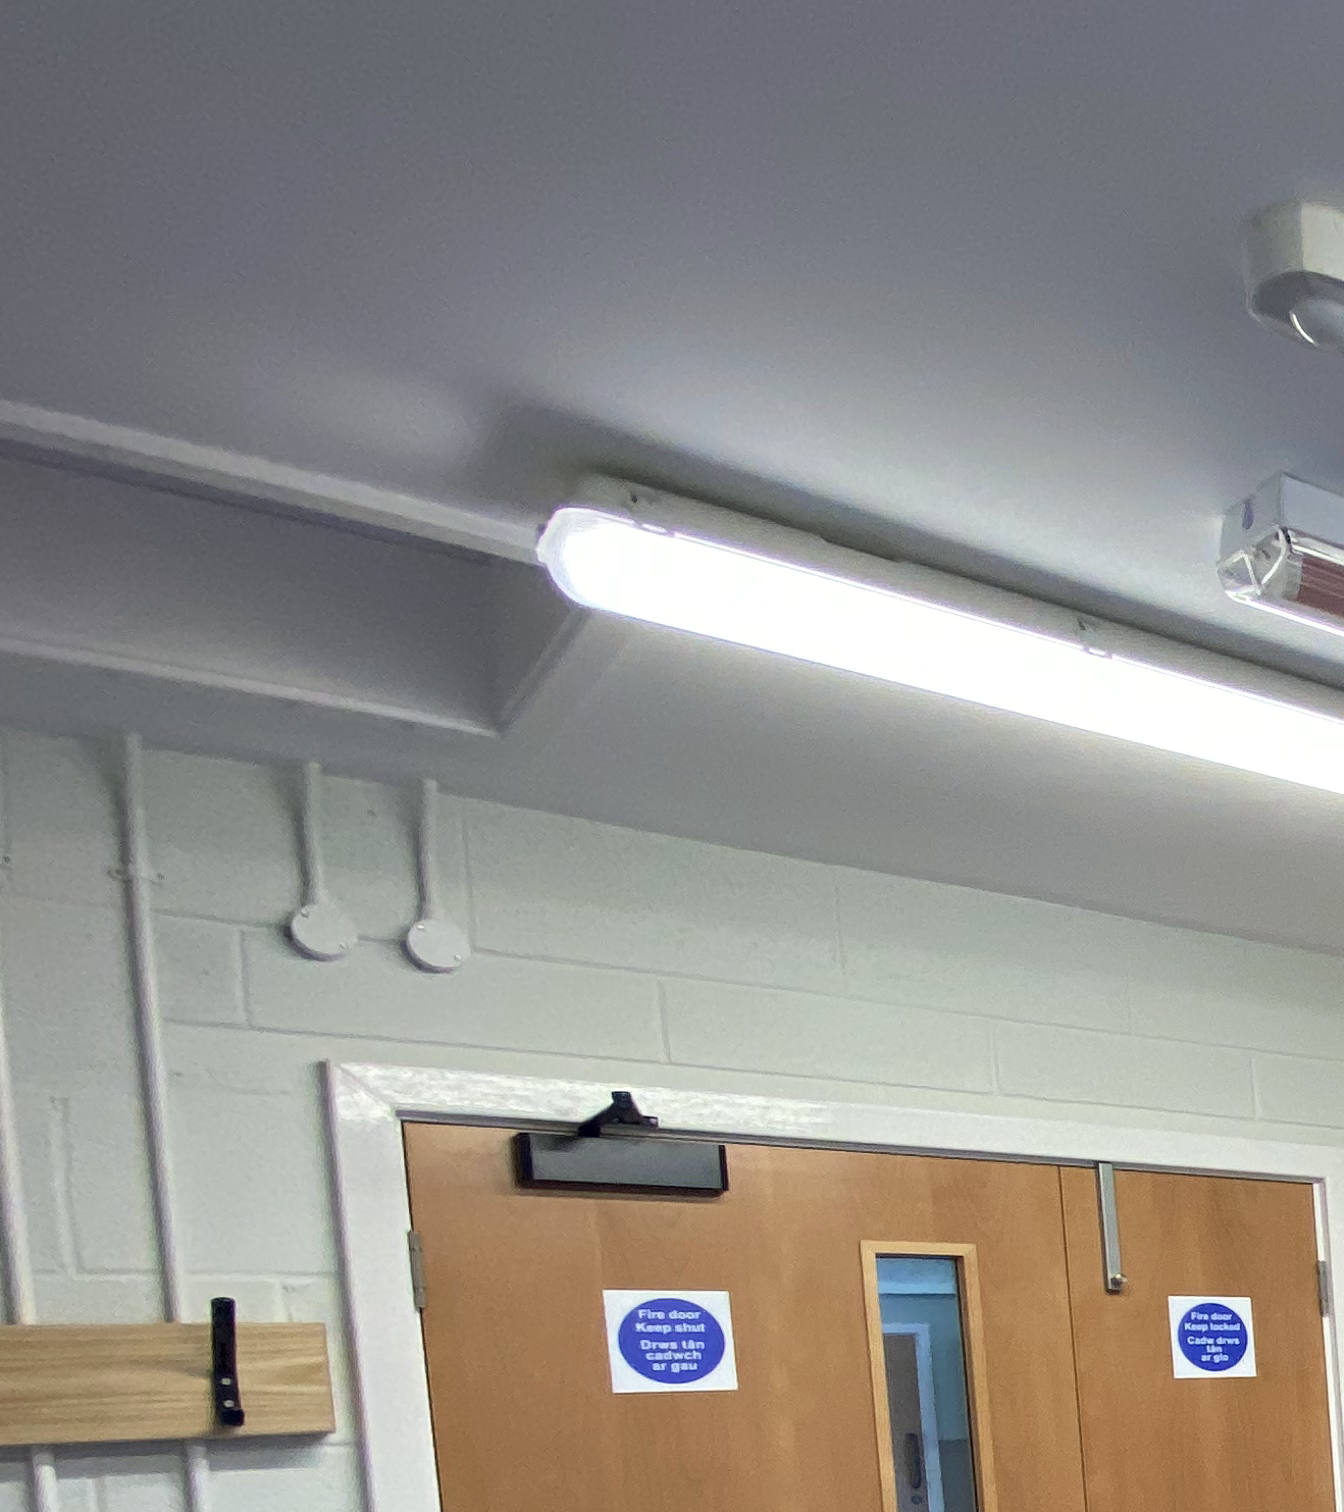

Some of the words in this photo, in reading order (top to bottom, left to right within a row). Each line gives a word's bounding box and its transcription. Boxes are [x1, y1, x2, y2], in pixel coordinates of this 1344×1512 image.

[638, 1309, 665, 1320] Fire
[669, 1309, 701, 1320] door
[1191, 1312, 1209, 1320] Fire
[1211, 1312, 1232, 1320] door
[636, 1322, 671, 1335] Keep
[675, 1322, 705, 1333] shut
[1184, 1323, 1208, 1332] Keep
[1210, 1323, 1241, 1331] locked
[640, 1340, 678, 1350] Drws
[1187, 1336, 1215, 1344] Cadw
[1216, 1337, 1240, 1345] drws
[646, 1351, 702, 1361] cadwch
[652, 1362, 666, 1371] ar
[671, 1361, 698, 1373] gau
